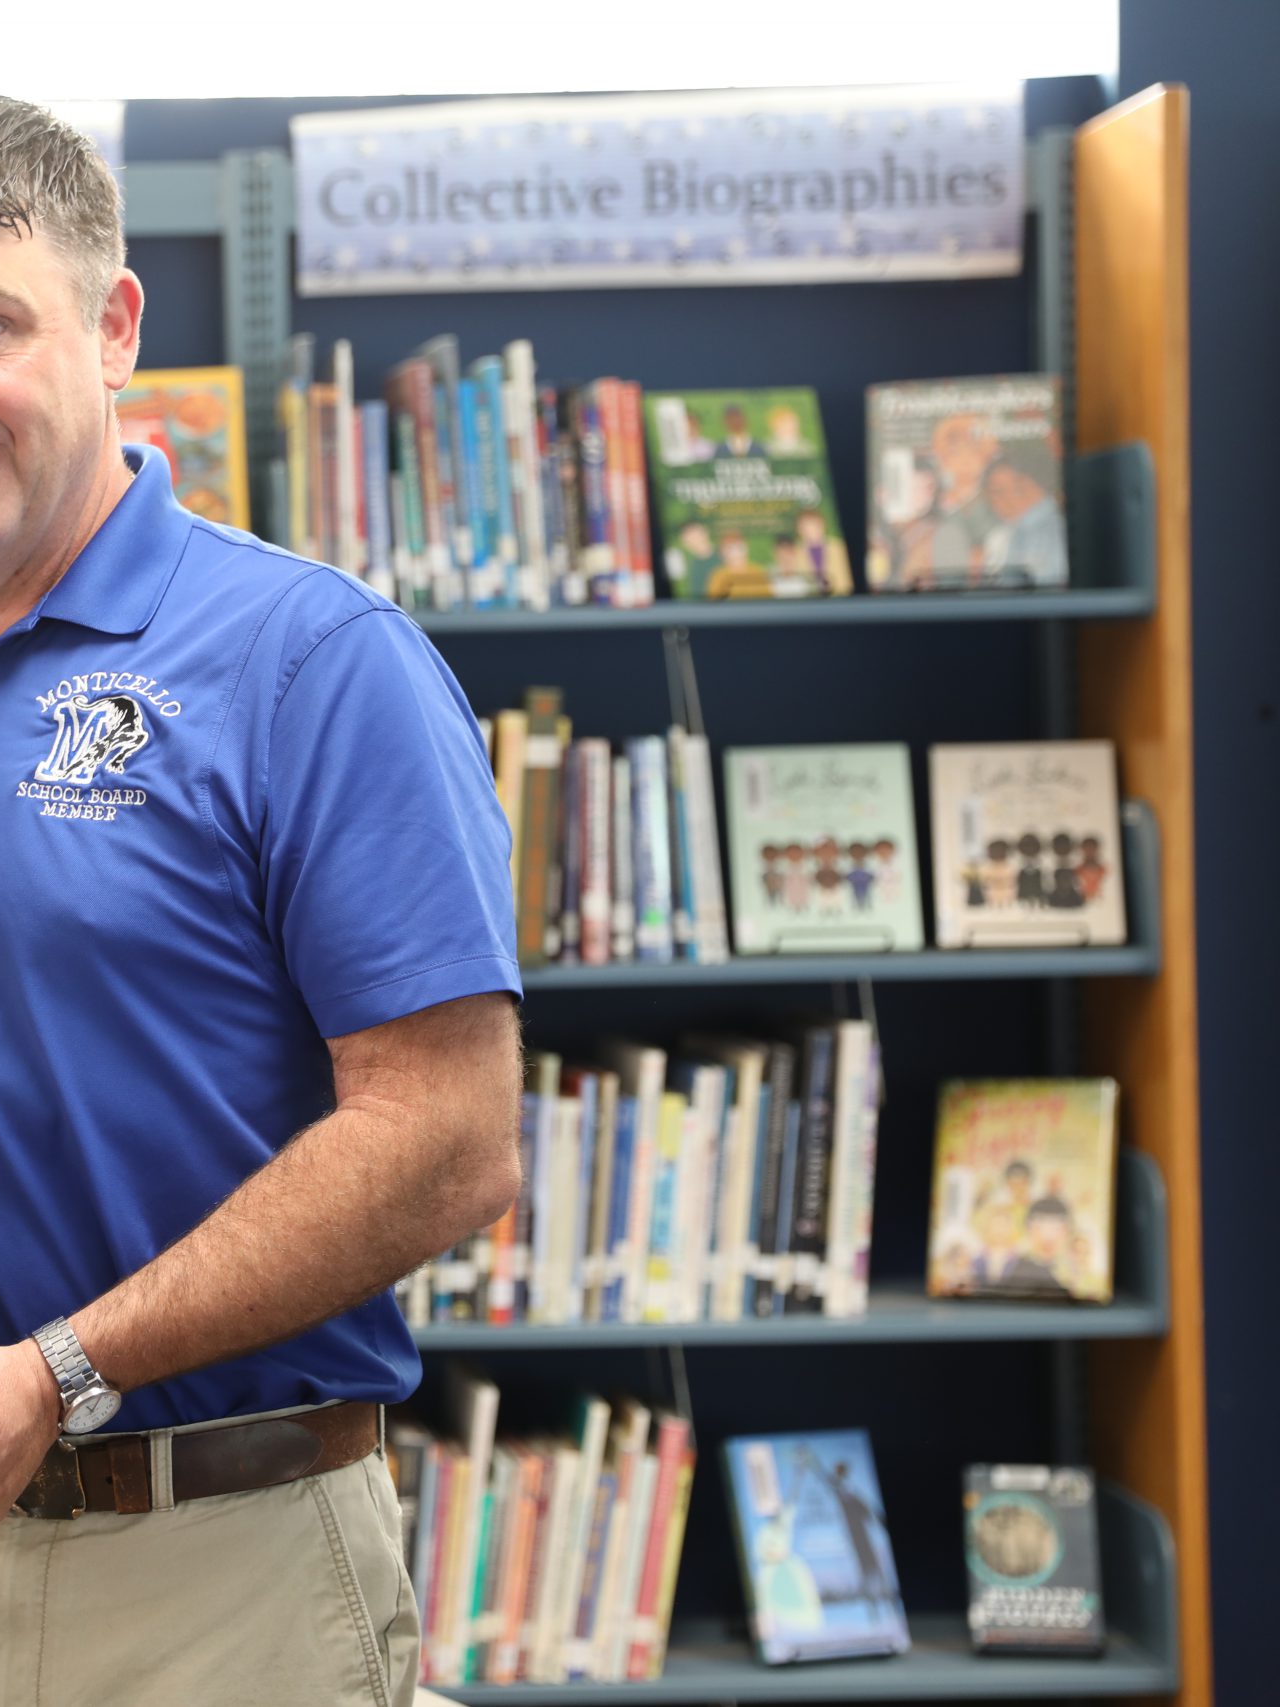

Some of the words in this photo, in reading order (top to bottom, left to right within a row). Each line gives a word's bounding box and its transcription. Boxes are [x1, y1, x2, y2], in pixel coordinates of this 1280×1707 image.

[317, 163, 626, 228] Collective
[641, 150, 1008, 230] Biographies
[36, 672, 182, 717] MONTICELLO
[16, 781, 85, 802] SCHOOL
[88, 788, 147, 805] BOARD
[40, 801, 117, 821] MEMBER
